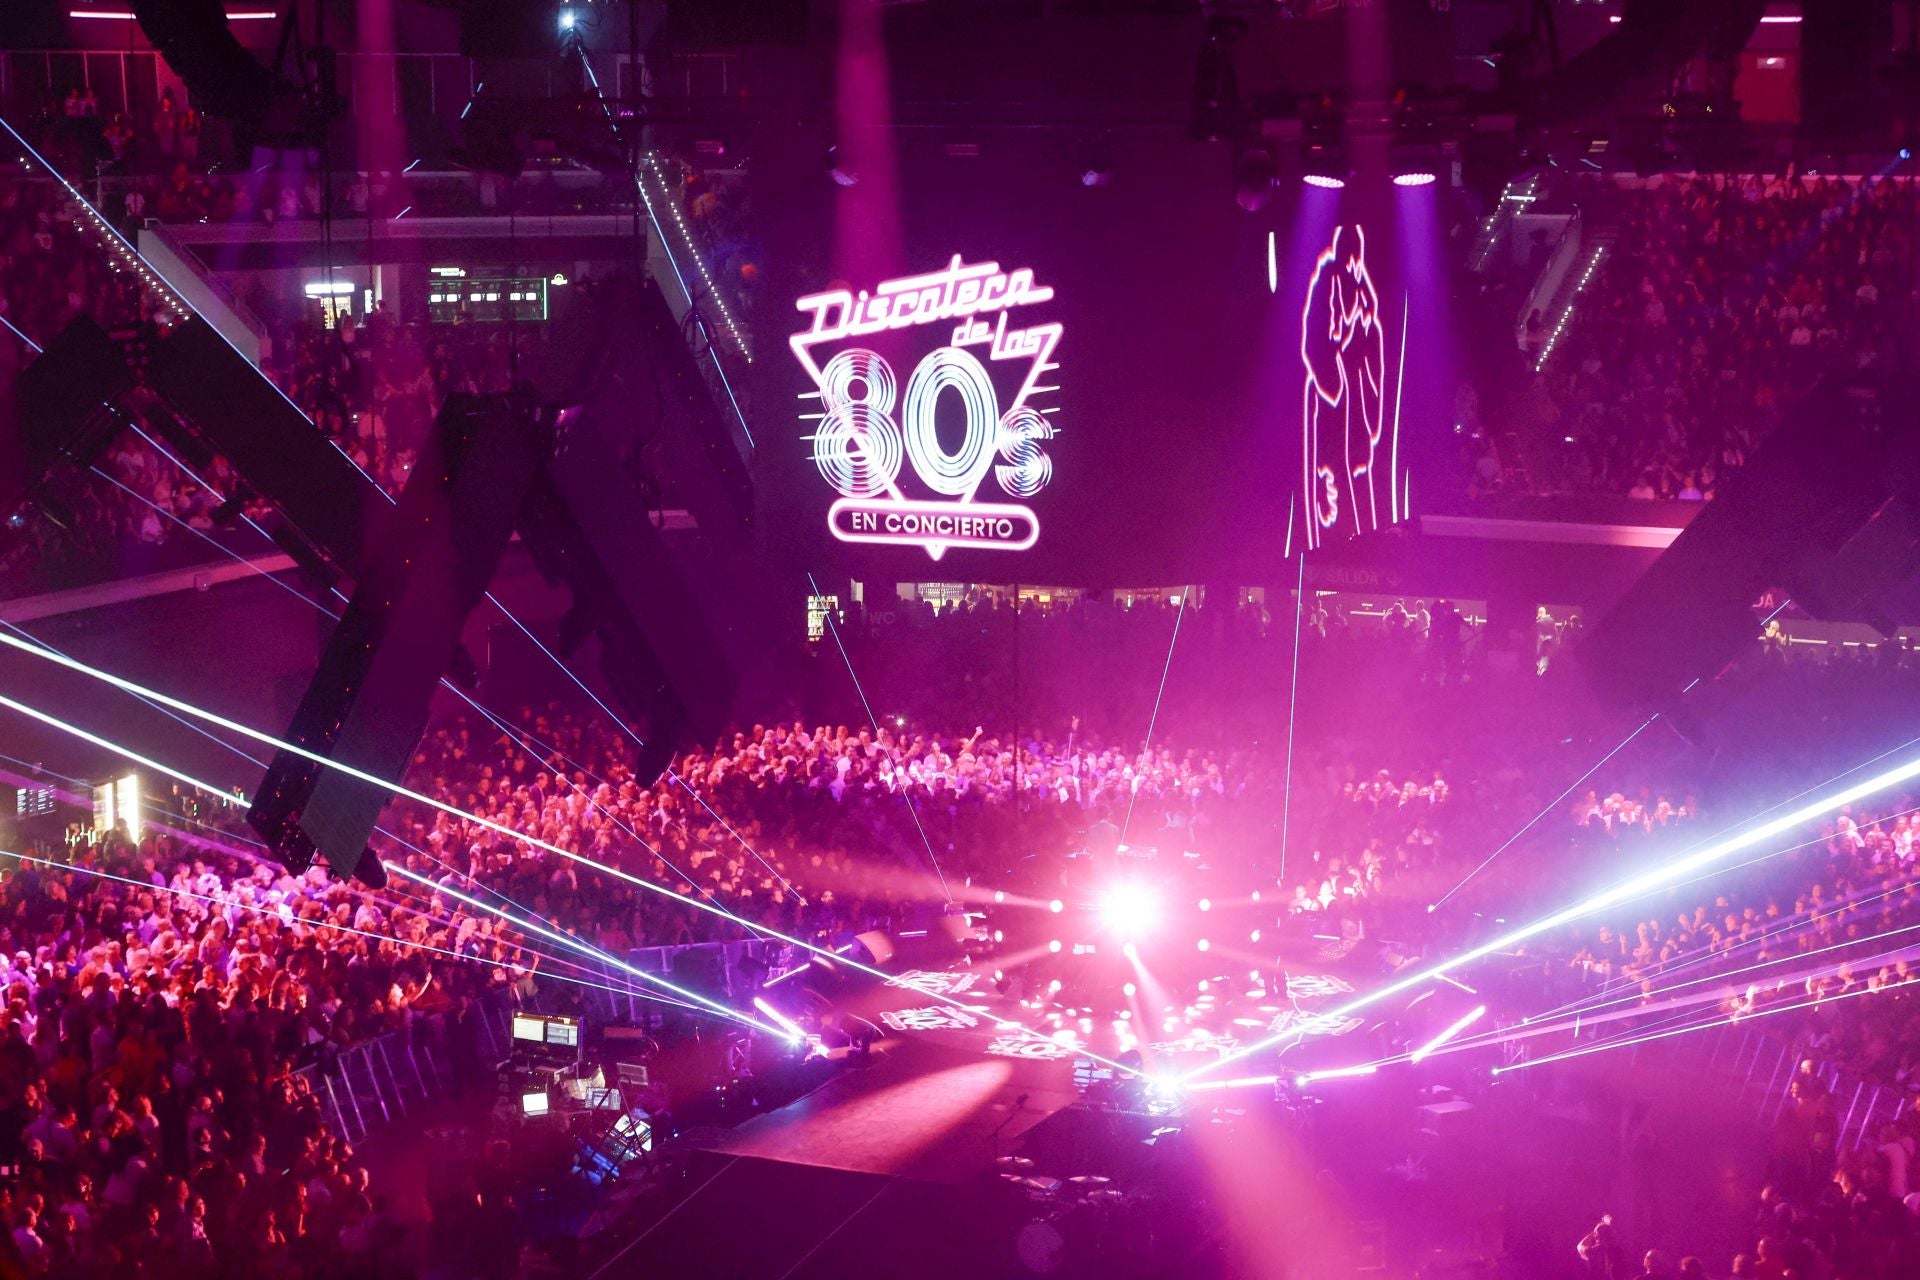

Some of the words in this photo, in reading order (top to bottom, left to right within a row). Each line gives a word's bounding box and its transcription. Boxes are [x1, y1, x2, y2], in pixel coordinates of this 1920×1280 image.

[792, 254, 1053, 340] Discoteca
[951, 316, 993, 347] de
[852, 512, 877, 531] EN
[885, 514, 1014, 537] CONCIERTO
[1327, 568, 1379, 585] SALIDA
